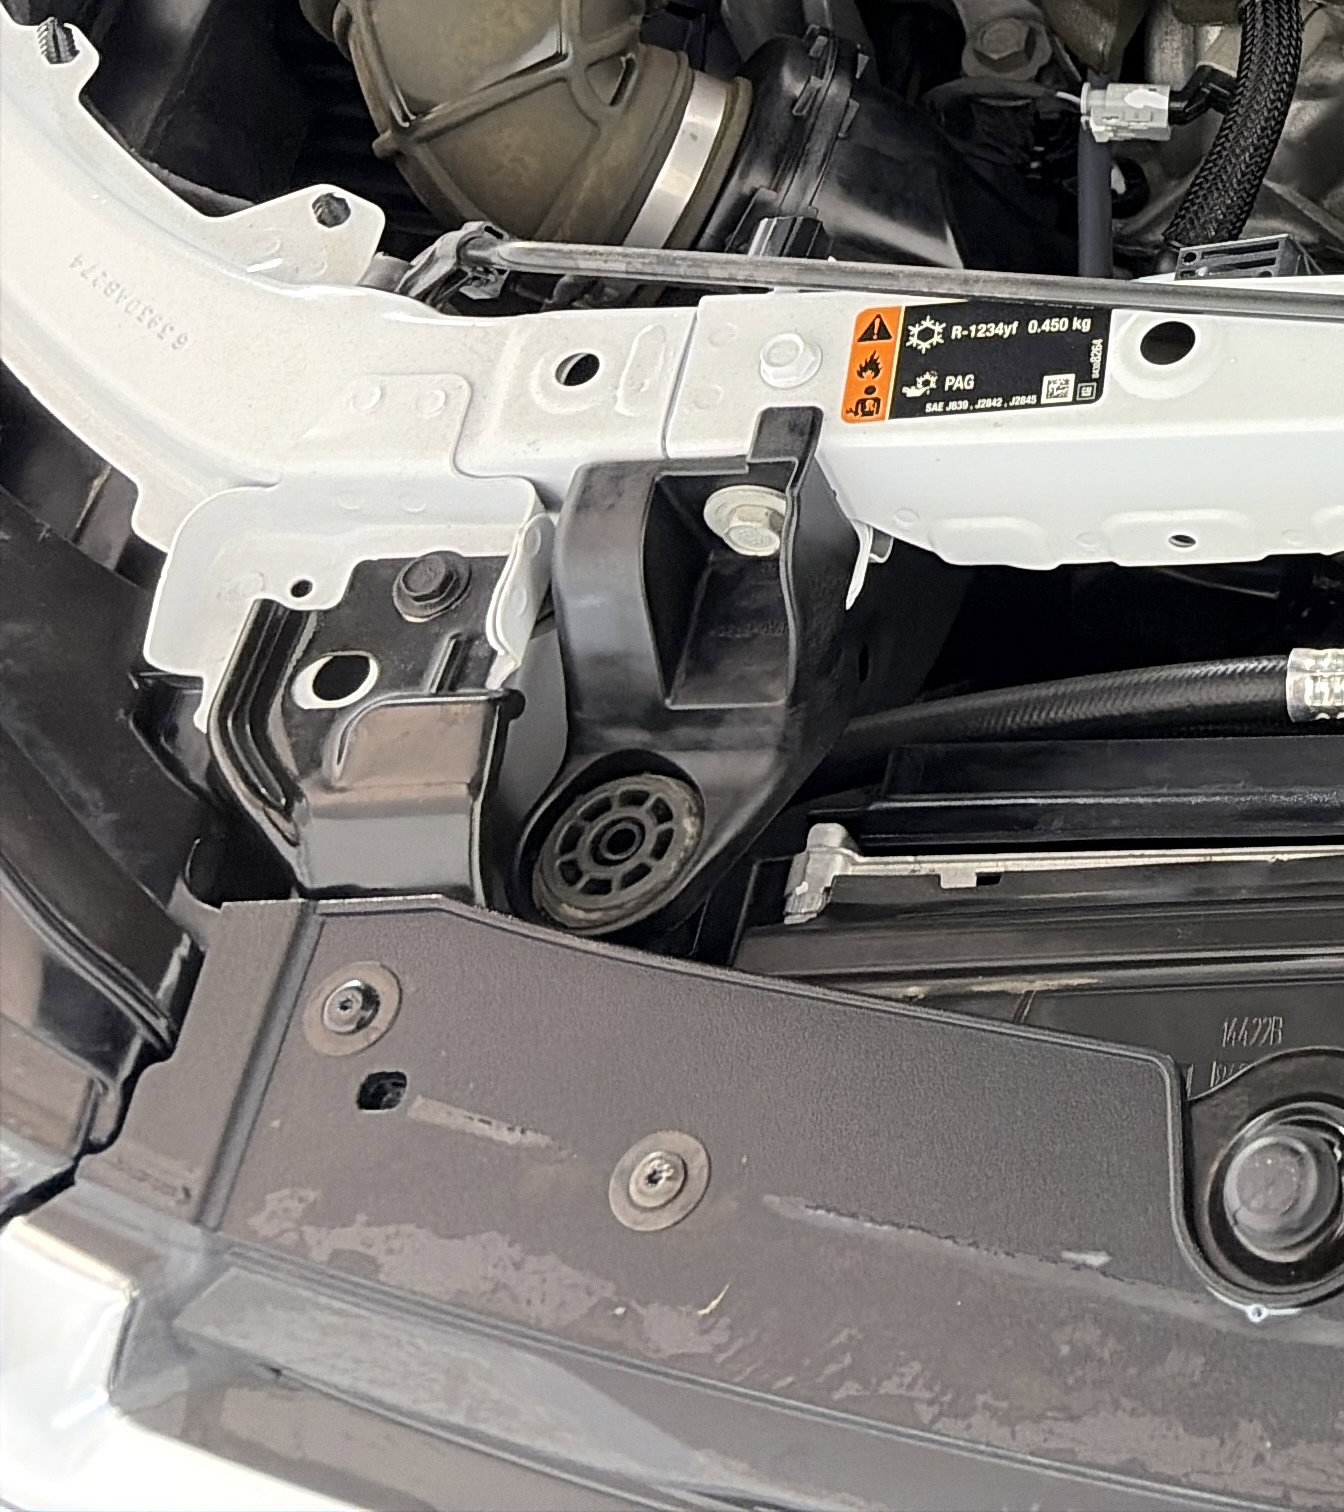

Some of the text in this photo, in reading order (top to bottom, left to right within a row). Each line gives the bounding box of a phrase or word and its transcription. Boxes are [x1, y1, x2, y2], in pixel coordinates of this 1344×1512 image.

[951, 317, 1091, 341] R-1234yf 0.450 kg
[944, 374, 975, 392] PAG
[925, 402, 943, 413] SAE
